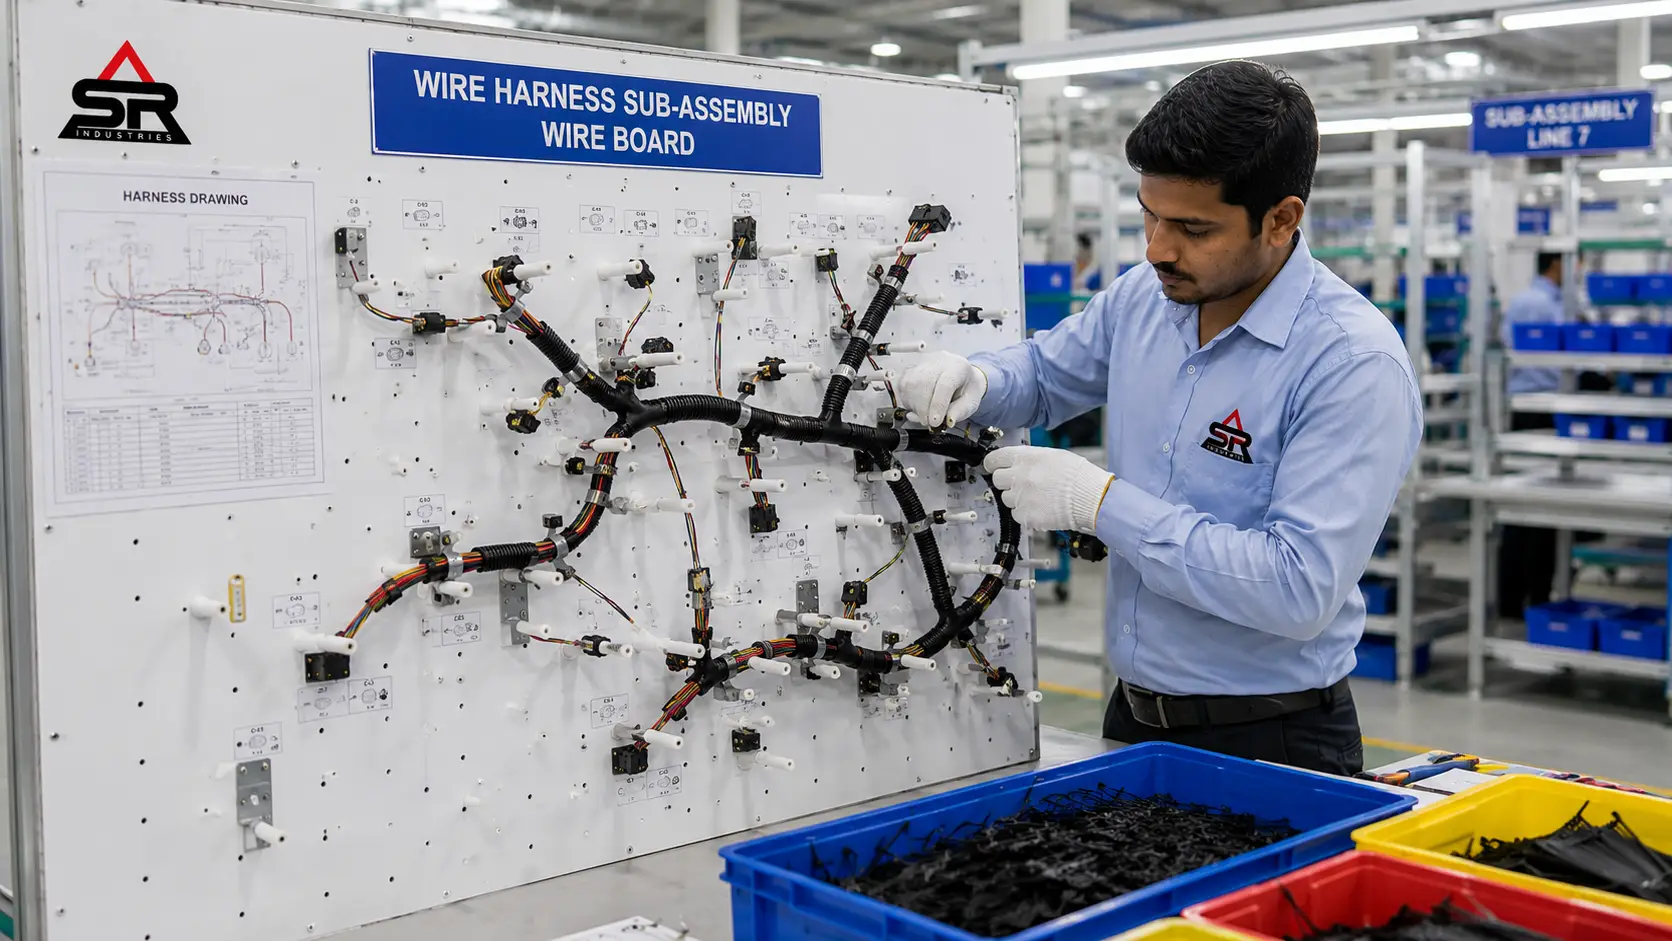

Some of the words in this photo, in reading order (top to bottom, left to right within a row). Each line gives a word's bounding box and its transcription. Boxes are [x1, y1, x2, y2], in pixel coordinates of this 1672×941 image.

[58, 78, 191, 145] SR
[414, 69, 486, 103] WIRE
[494, 77, 616, 115] HARNESS
[624, 88, 792, 128] SUB-ASSEMBLY
[1485, 98, 1638, 128] SUB-ASSEMBLY
[75, 129, 172, 142] INDUSTRIES
[541, 121, 605, 151] WIRE
[613, 125, 695, 156] BOARD
[1527, 126, 1573, 149] LINE
[1578, 125, 1591, 147] 7
[123, 190, 186, 204] HARNESS
[190, 192, 249, 206] DRAWING
